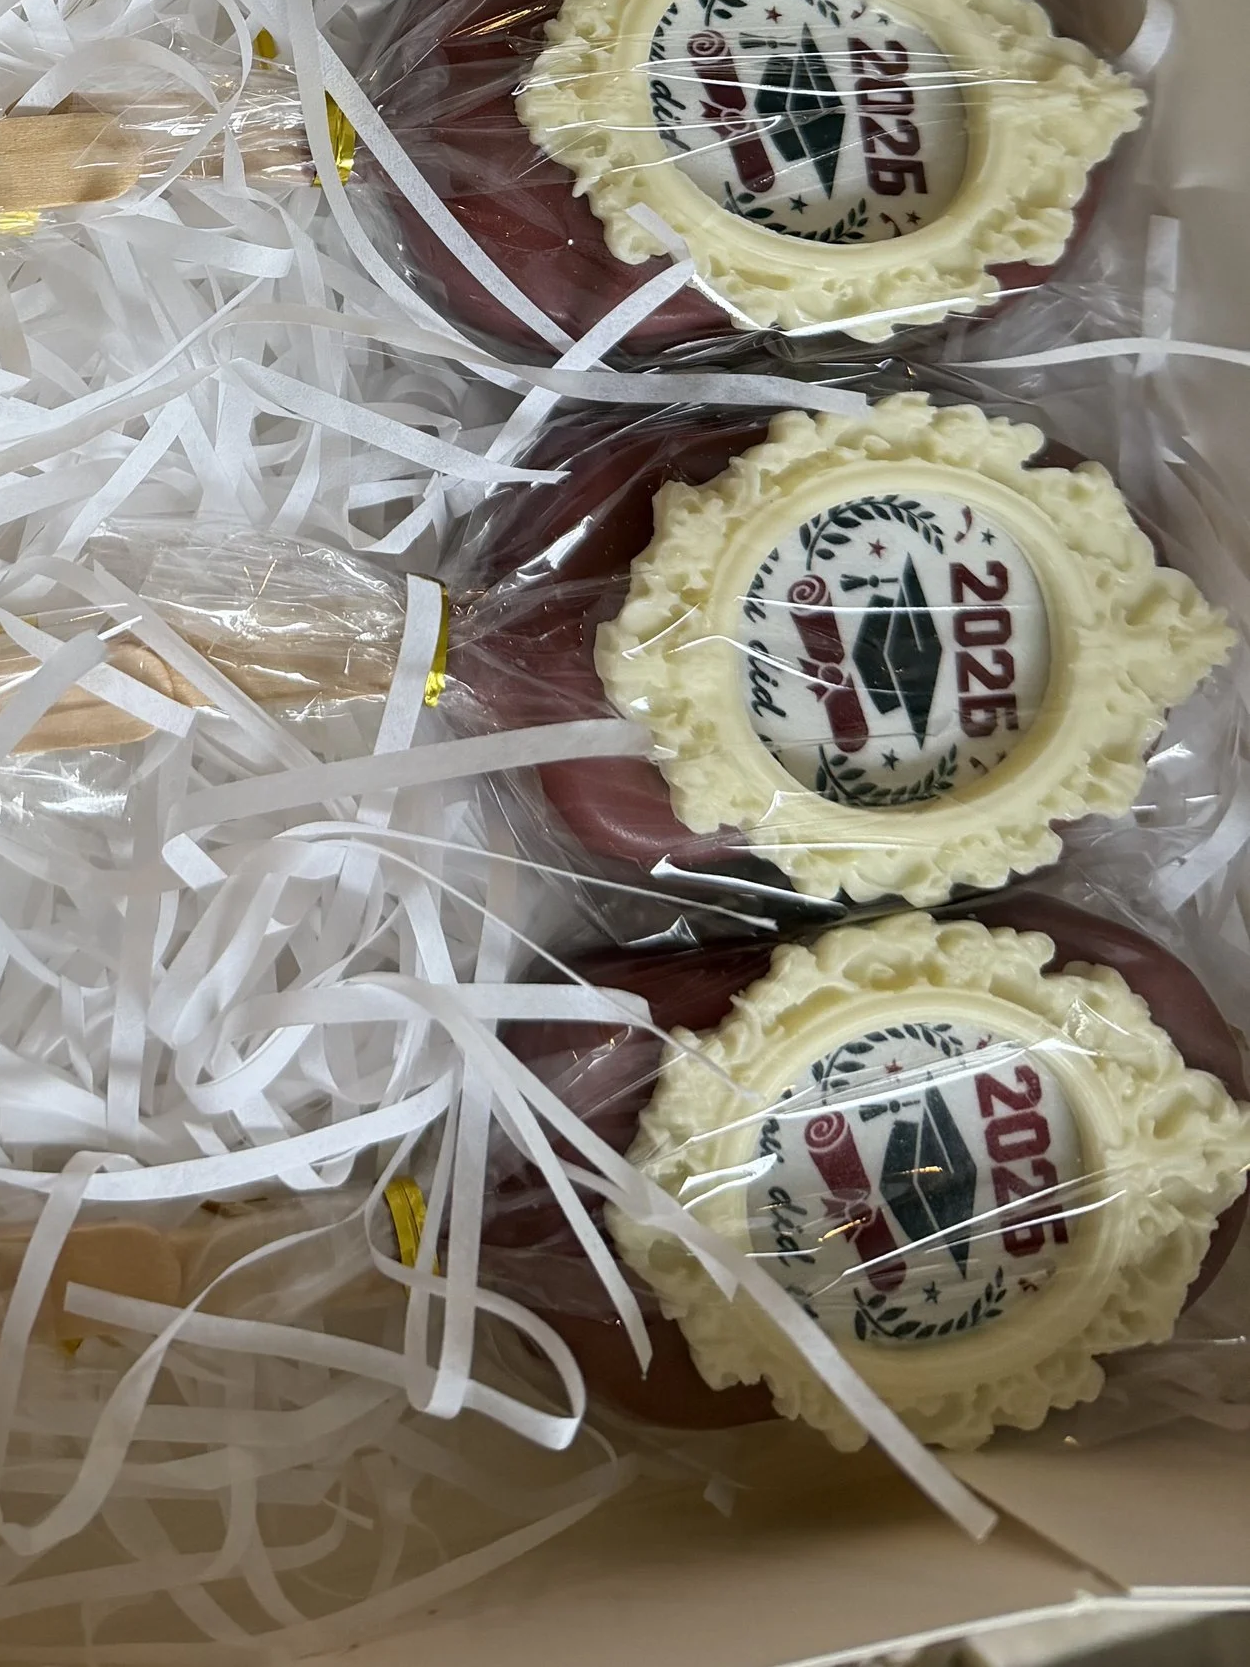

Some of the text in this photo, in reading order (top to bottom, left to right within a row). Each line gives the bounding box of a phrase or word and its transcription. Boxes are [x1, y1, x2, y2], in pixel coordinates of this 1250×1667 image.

[848, 37, 927, 196] 2026
[748, 641, 786, 718] did
[949, 560, 1019, 737] 2026
[769, 1187, 816, 1267] did
[974, 1065, 1069, 1257] 2026
